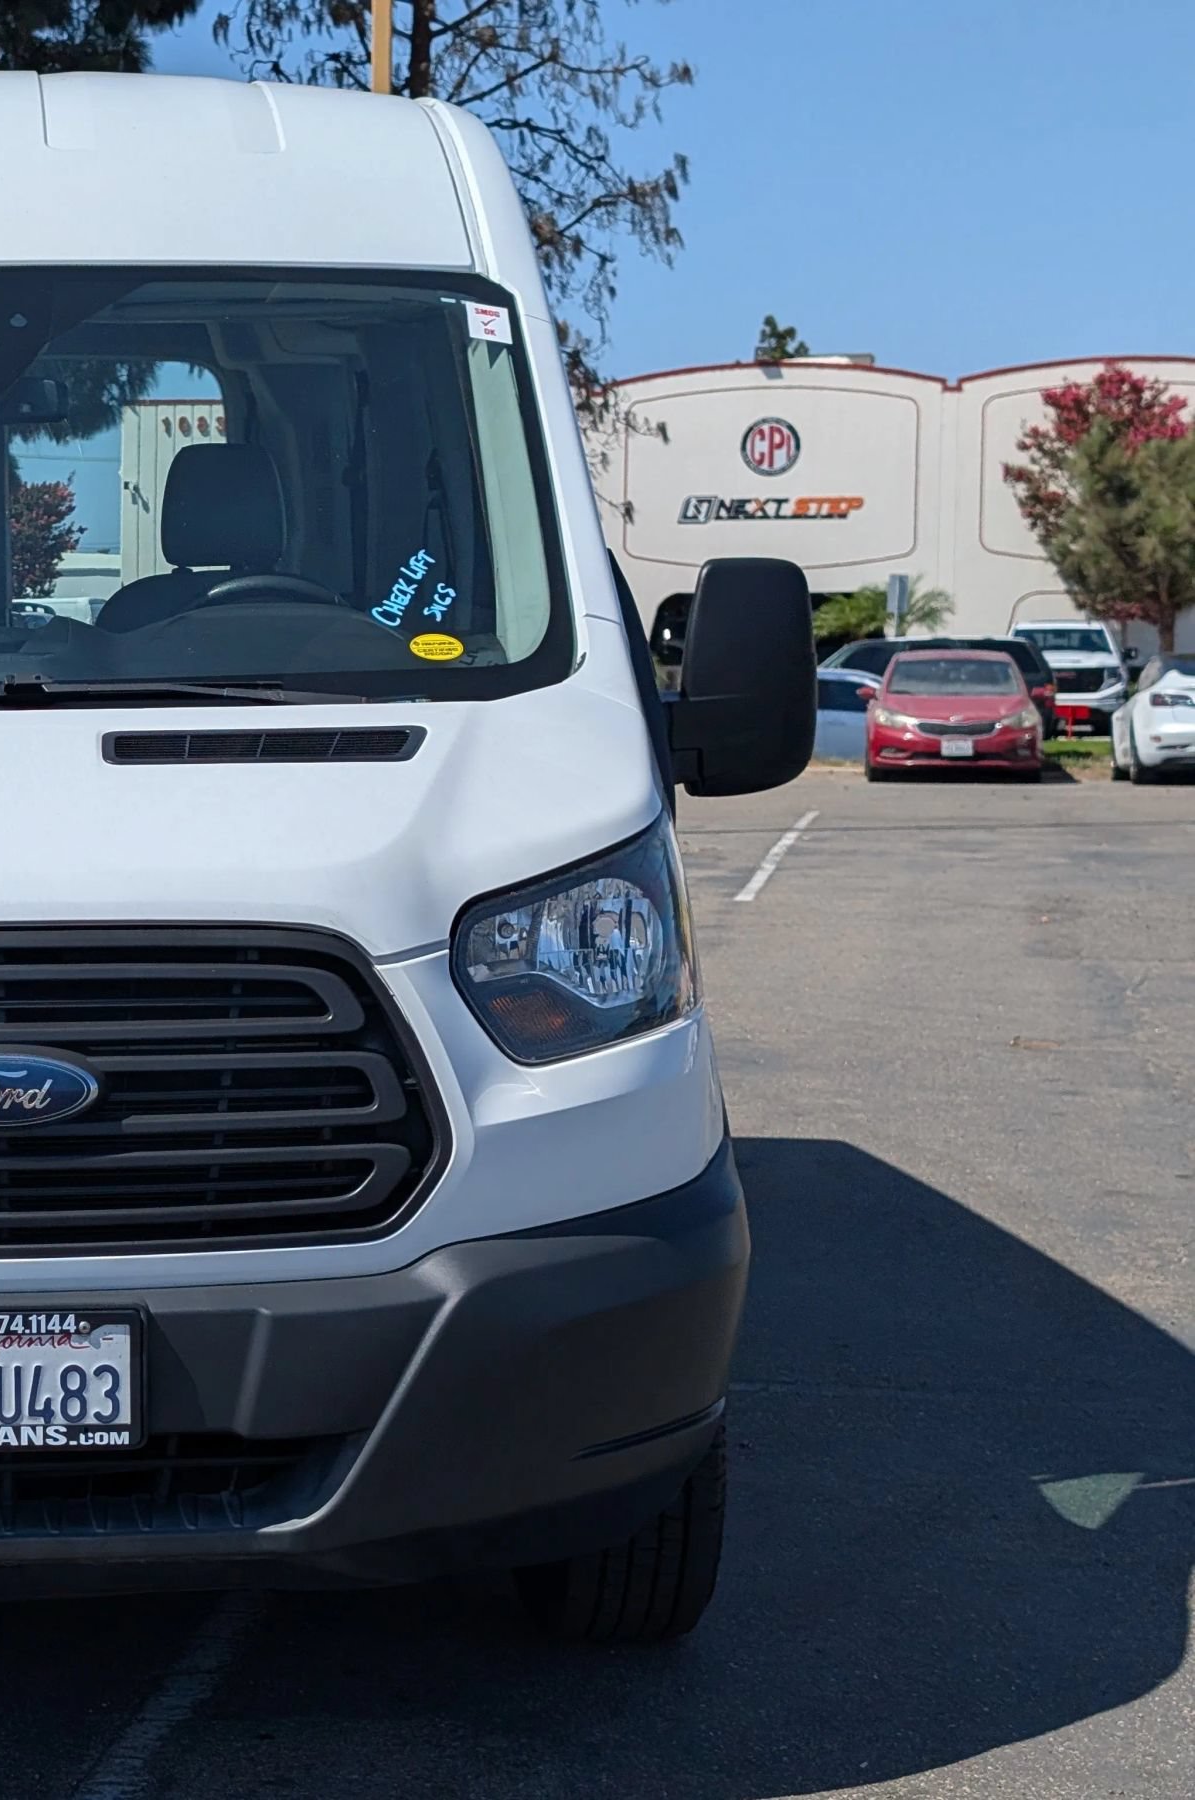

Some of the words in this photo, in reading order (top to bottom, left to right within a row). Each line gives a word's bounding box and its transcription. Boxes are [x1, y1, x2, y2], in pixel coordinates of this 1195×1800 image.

[484, 328, 496, 336] OK
[749, 425, 792, 469] CPI
[714, 497, 789, 520] NEXT
[371, 578, 418, 626] CHECK
[399, 549, 436, 580] LIFT
